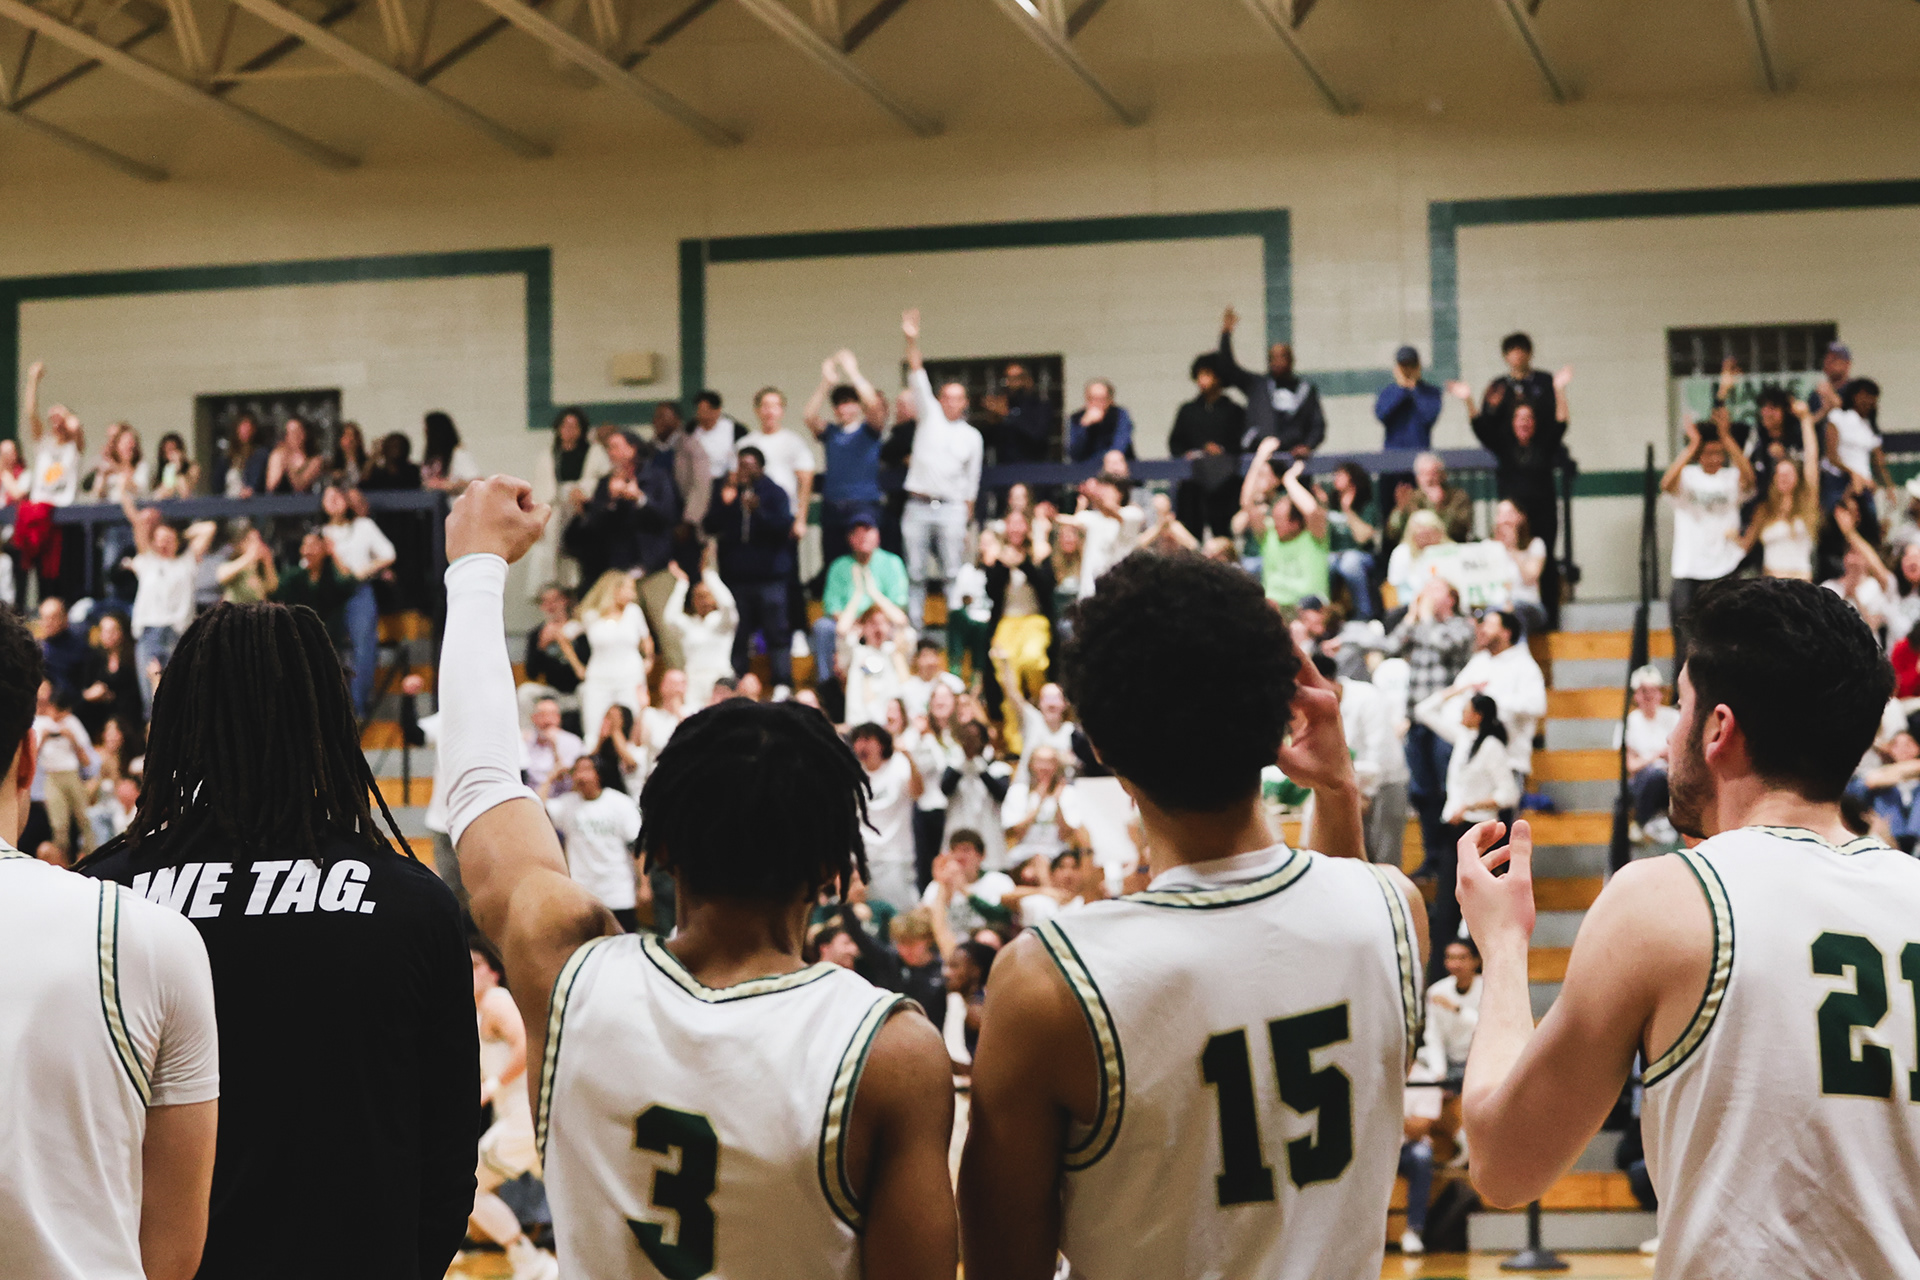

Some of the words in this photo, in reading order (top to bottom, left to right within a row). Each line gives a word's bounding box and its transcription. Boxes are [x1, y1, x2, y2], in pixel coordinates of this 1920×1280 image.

[132, 861, 234, 919] WE
[244, 858, 377, 916] TAG.
[626, 1104, 719, 1280] 3
[1200, 1001, 1354, 1207] 15
